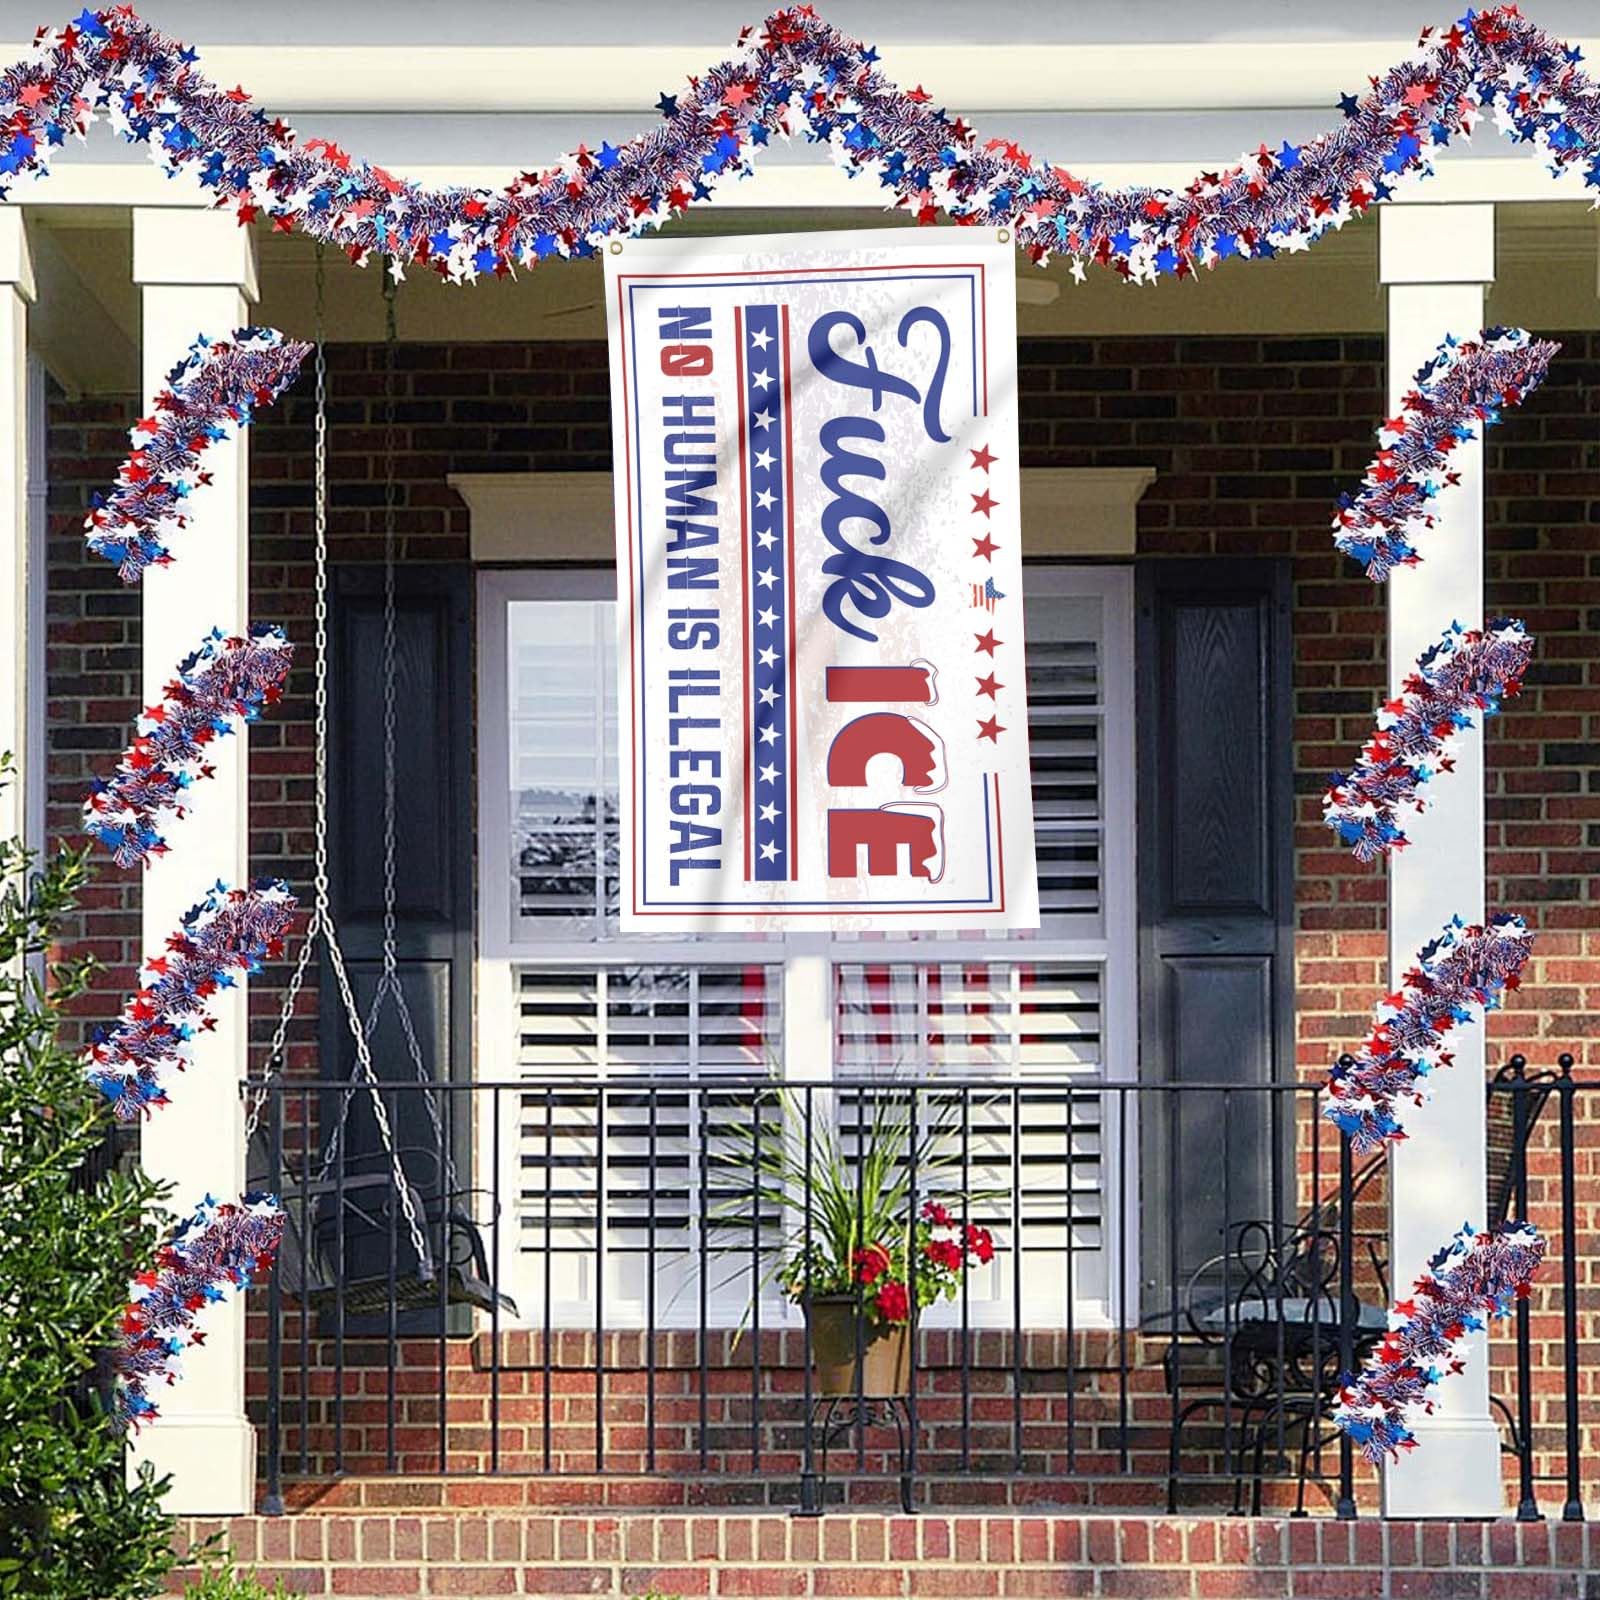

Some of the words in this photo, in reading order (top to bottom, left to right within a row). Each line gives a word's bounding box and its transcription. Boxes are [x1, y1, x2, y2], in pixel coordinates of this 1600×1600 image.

[662, 394, 720, 589] HUMAN
[808, 306, 952, 642] Fuck
[667, 606, 721, 650] IS
[668, 668, 722, 886] ILLEGAL
[826, 658, 949, 884] ICE
